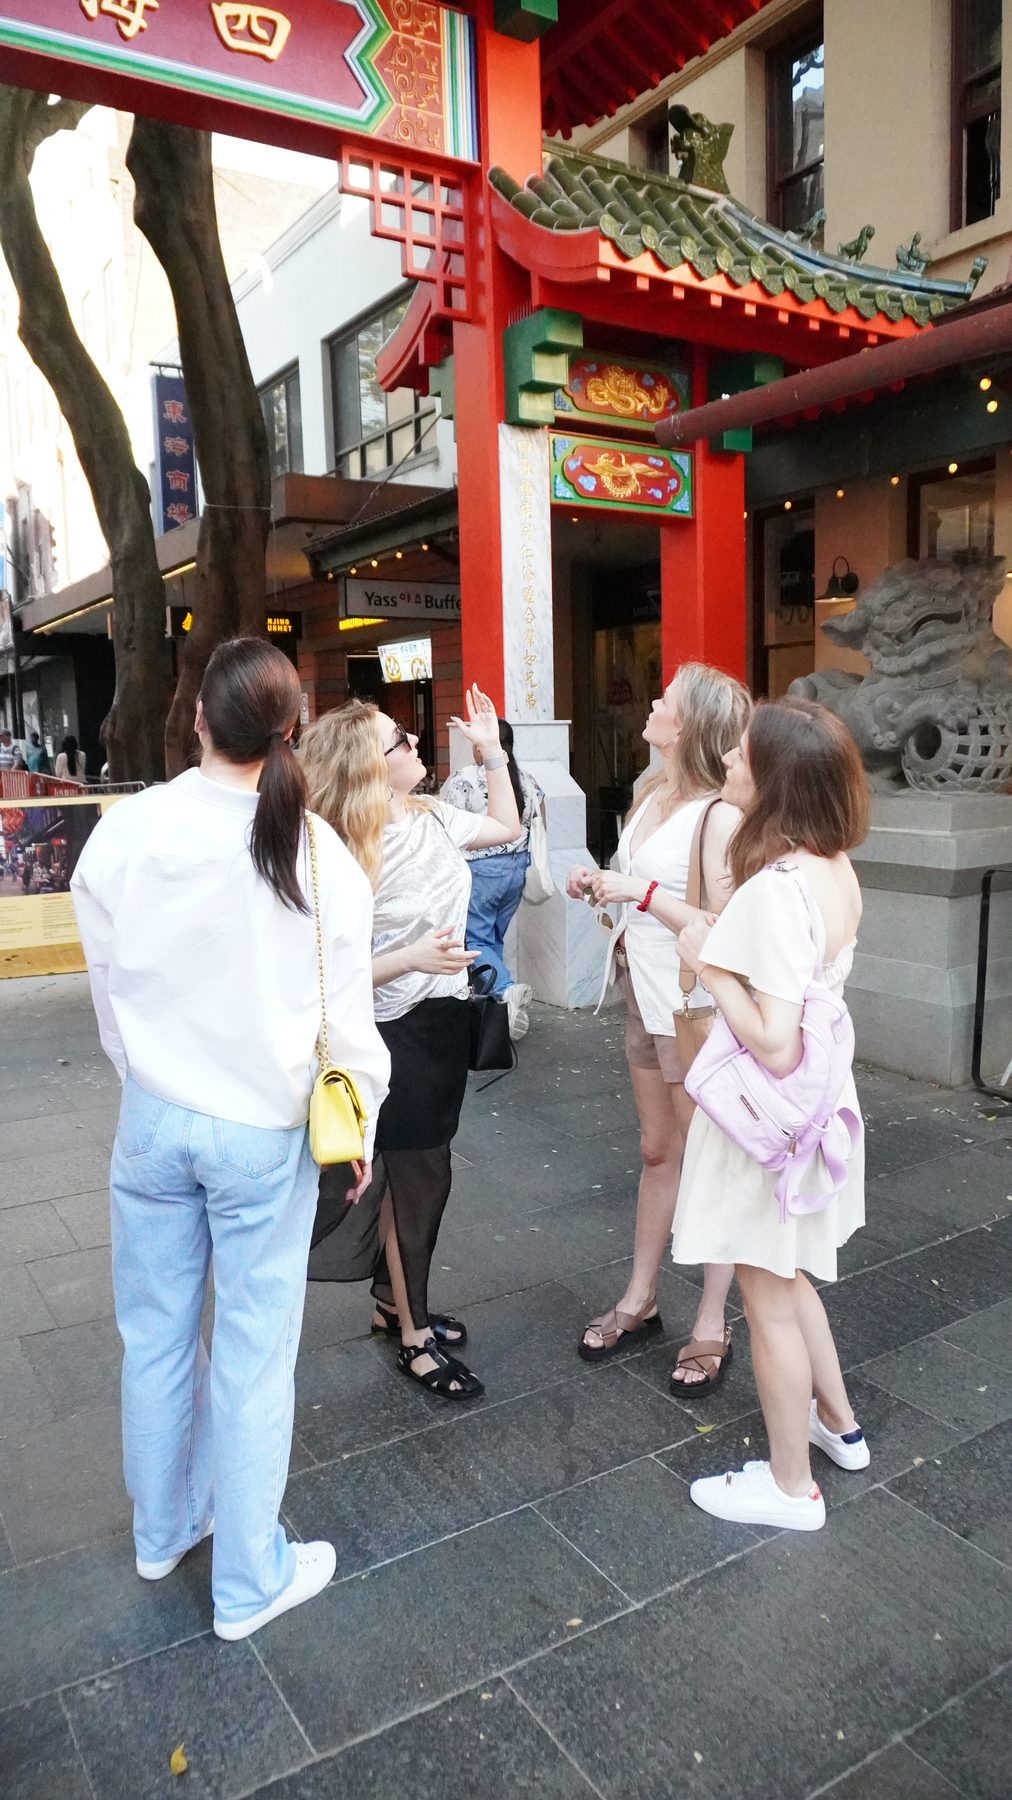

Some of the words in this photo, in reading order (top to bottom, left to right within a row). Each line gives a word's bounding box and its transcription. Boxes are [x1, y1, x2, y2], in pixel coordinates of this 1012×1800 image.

[163, 399, 191, 525] 東海商場
[365, 591, 397, 607] Yass
